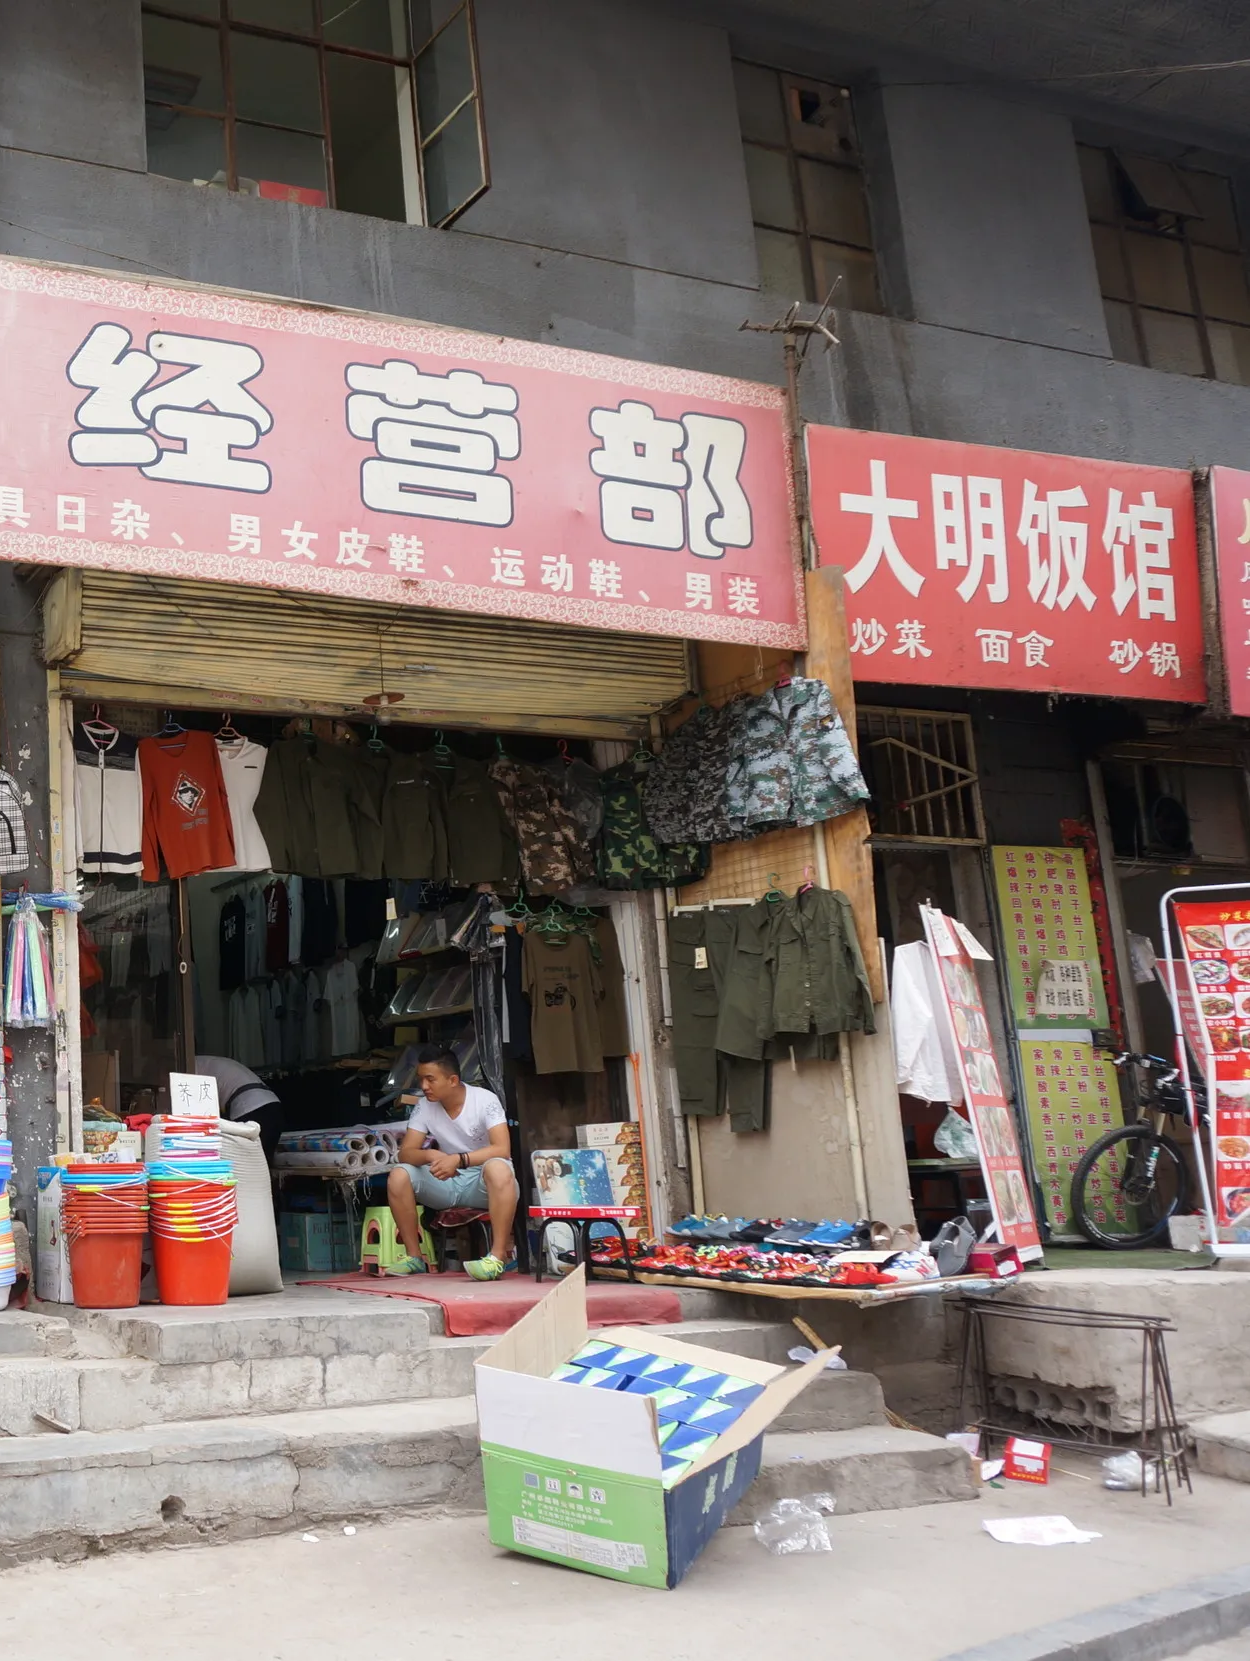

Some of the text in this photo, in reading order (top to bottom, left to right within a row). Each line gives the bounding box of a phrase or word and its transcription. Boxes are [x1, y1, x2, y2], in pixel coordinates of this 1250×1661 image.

[839, 459, 1177, 622] 大明饭馆
[850, 617, 1182, 679] 炒菜 面食 砂锅
[1034, 1064, 1105, 1077] 酸辣土豆丝
